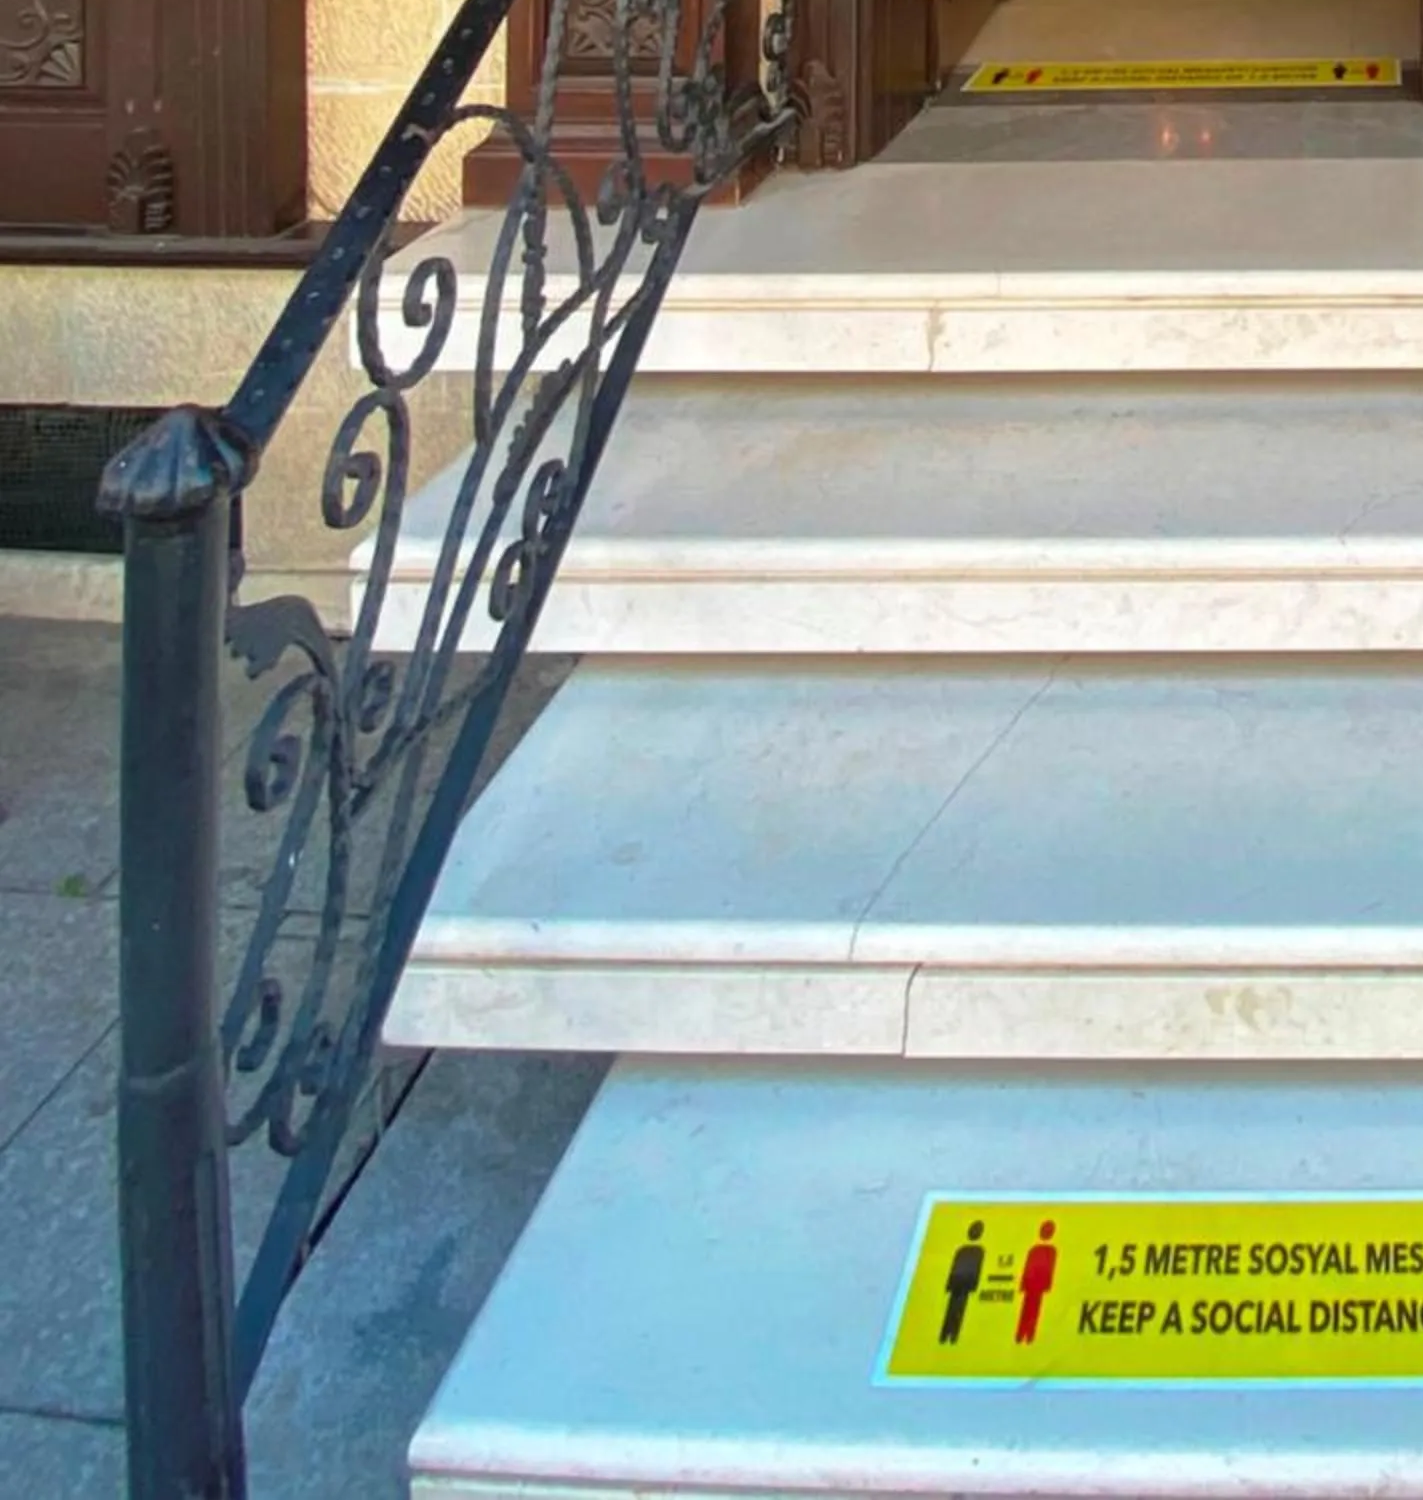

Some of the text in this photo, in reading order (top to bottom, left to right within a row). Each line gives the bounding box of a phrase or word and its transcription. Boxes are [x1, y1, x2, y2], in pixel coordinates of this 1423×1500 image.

[1093, 1243, 1137, 1281] 1,5
[1143, 1244, 1241, 1276] METRE
[1246, 1243, 1358, 1276] SOSYAL
[1077, 1300, 1156, 1335] KEEP
[1159, 1300, 1185, 1335] A
[1190, 1300, 1302, 1335] SOCIAL
